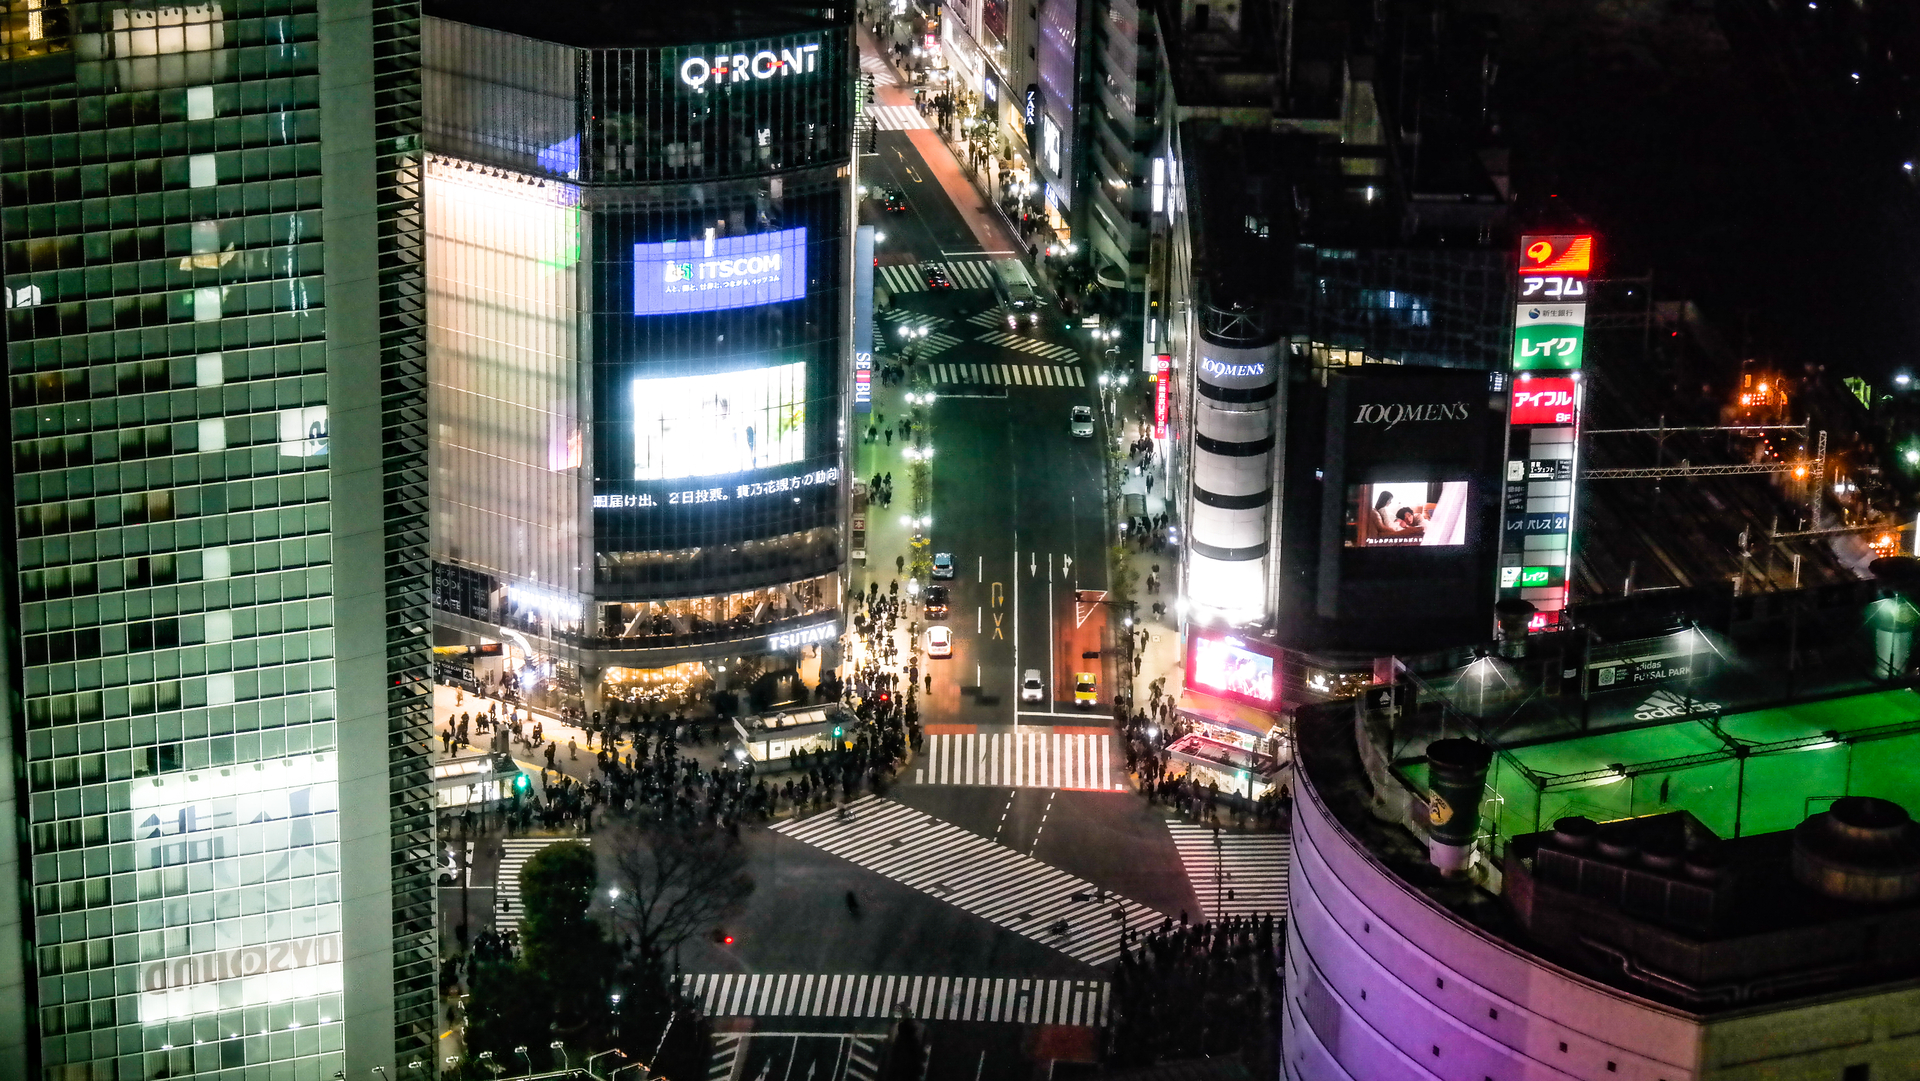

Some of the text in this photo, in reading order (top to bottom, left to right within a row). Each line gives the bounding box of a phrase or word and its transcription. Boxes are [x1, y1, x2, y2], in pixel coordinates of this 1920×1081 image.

[681, 44, 819, 93] QFRONT
[1025, 91, 1035, 125] ZARA
[1523, 277, 1584, 296] アコム
[1542, 309, 1573, 317] 新生銀行
[1521, 338, 1577, 356] レイク
[856, 352, 871, 402] SEIBU
[1515, 391, 1572, 407] アイフル
[1555, 413, 1571, 422] 8F
[1523, 572, 1548, 581] レイク
[770, 625, 836, 650] TSUTAYA
